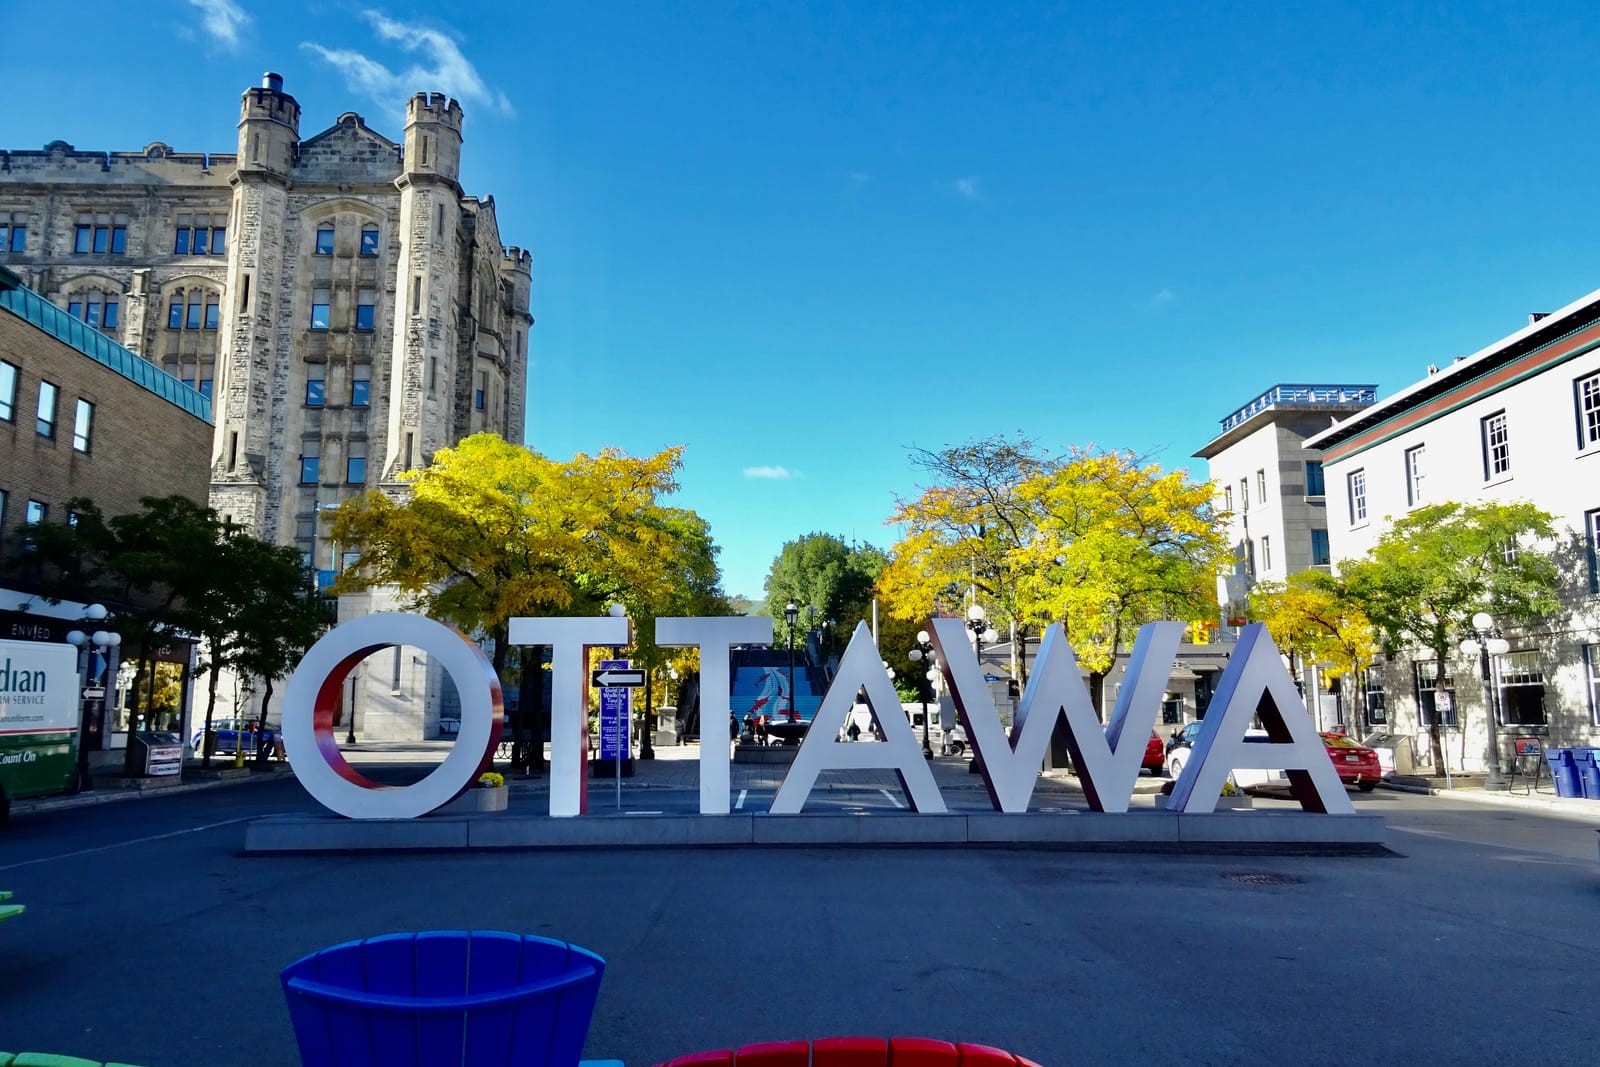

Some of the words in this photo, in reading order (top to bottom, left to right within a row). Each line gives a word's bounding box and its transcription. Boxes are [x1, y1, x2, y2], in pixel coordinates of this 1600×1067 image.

[12, 695, 45, 705] SERVICE
[281, 611, 1357, 819] OTTAWA
[23, 751, 37, 762] On
